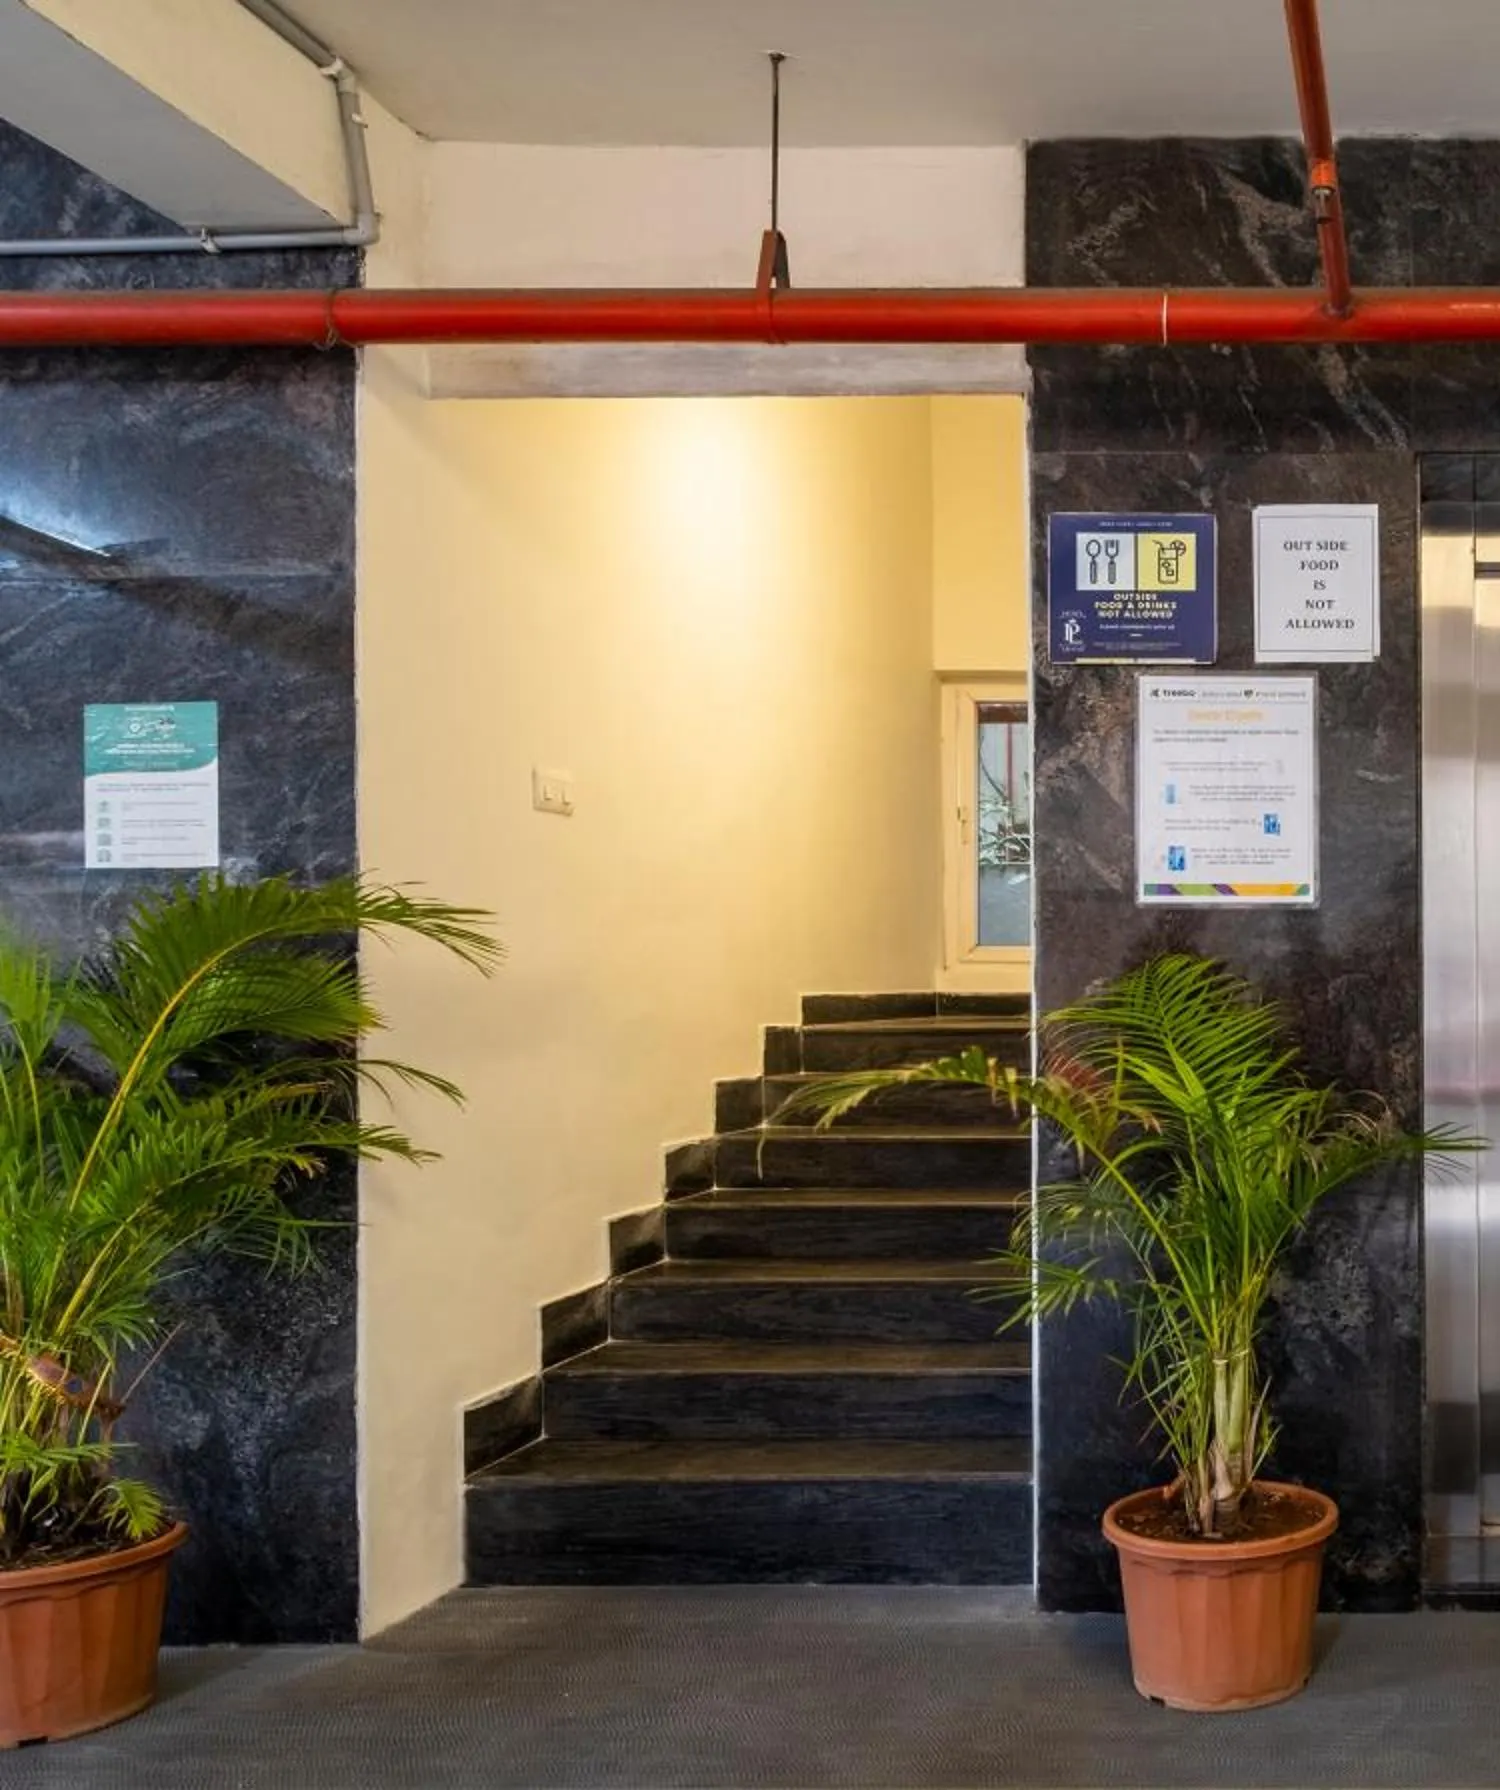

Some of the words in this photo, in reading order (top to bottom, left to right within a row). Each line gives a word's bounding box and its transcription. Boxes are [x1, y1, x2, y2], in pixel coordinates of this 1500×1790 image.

[1283, 540, 1312, 551] OUT
[1315, 540, 1348, 551] SIDE
[1300, 559, 1339, 571] FOOD
[1313, 579, 1326, 590] IS
[1113, 592, 1157, 601] OUTSIDE
[1094, 601, 1122, 609] FOOD
[1127, 601, 1134, 609] &
[1138, 601, 1177, 609] DRINKS
[1305, 599, 1335, 609] NOT
[1098, 609, 1119, 618] NOT
[1123, 609, 1173, 618] ALLOWED
[1286, 618, 1355, 629] ALLOWED
